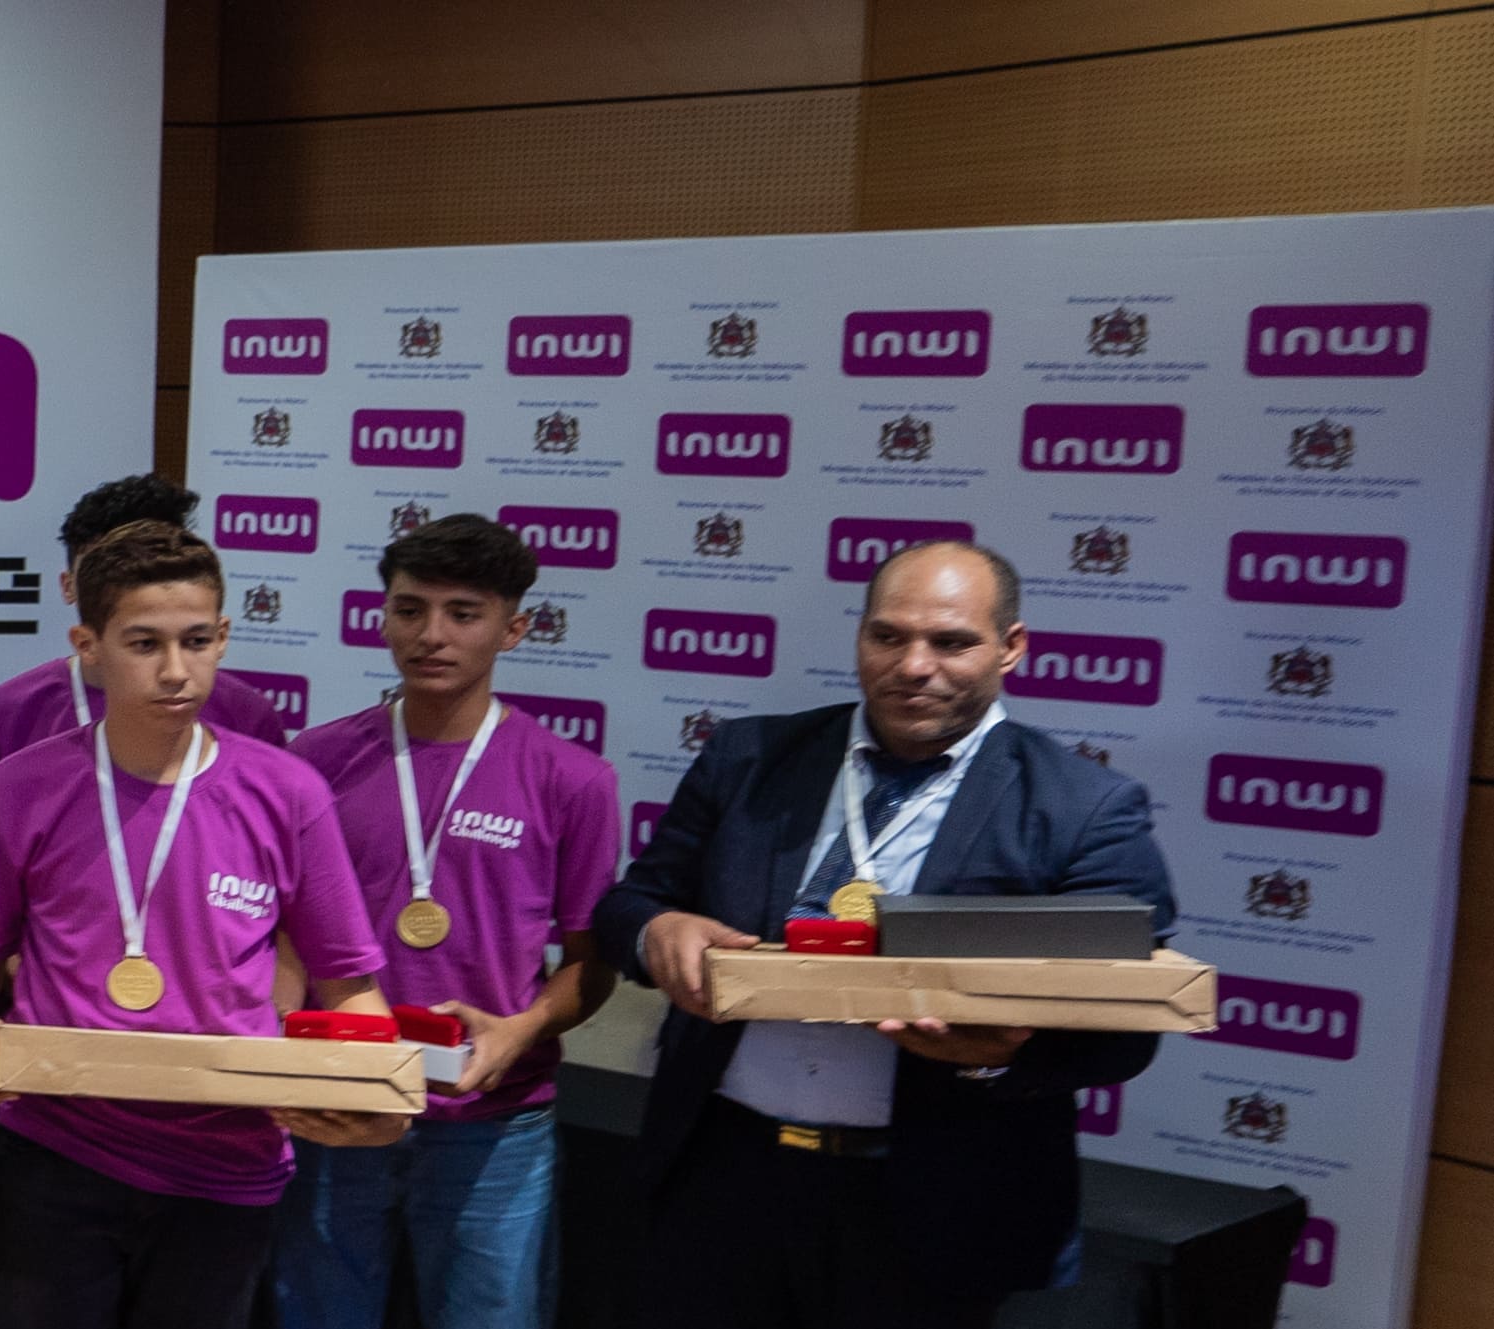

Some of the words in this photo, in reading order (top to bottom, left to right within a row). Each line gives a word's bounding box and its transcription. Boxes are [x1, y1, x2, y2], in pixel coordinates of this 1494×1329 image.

[230, 334, 322, 359] inwi
[515, 333, 623, 359] inwi
[852, 329, 980, 359] inwi
[1259, 325, 1415, 357] inwi
[358, 425, 457, 452] inwi
[665, 430, 781, 460] inwi
[1031, 436, 1171, 468] inwi
[221, 510, 312, 538] inwi
[837, 537, 907, 564] in
[1238, 552, 1394, 588] inwi
[348, 606, 385, 631] in
[651, 626, 767, 660] inwi
[1218, 774, 1370, 817] inwi
[448, 824, 521, 850] Challenge
[451, 809, 525, 837] inwi
[208, 872, 276, 903] inwi
[1219, 997, 1348, 1039] nwi
